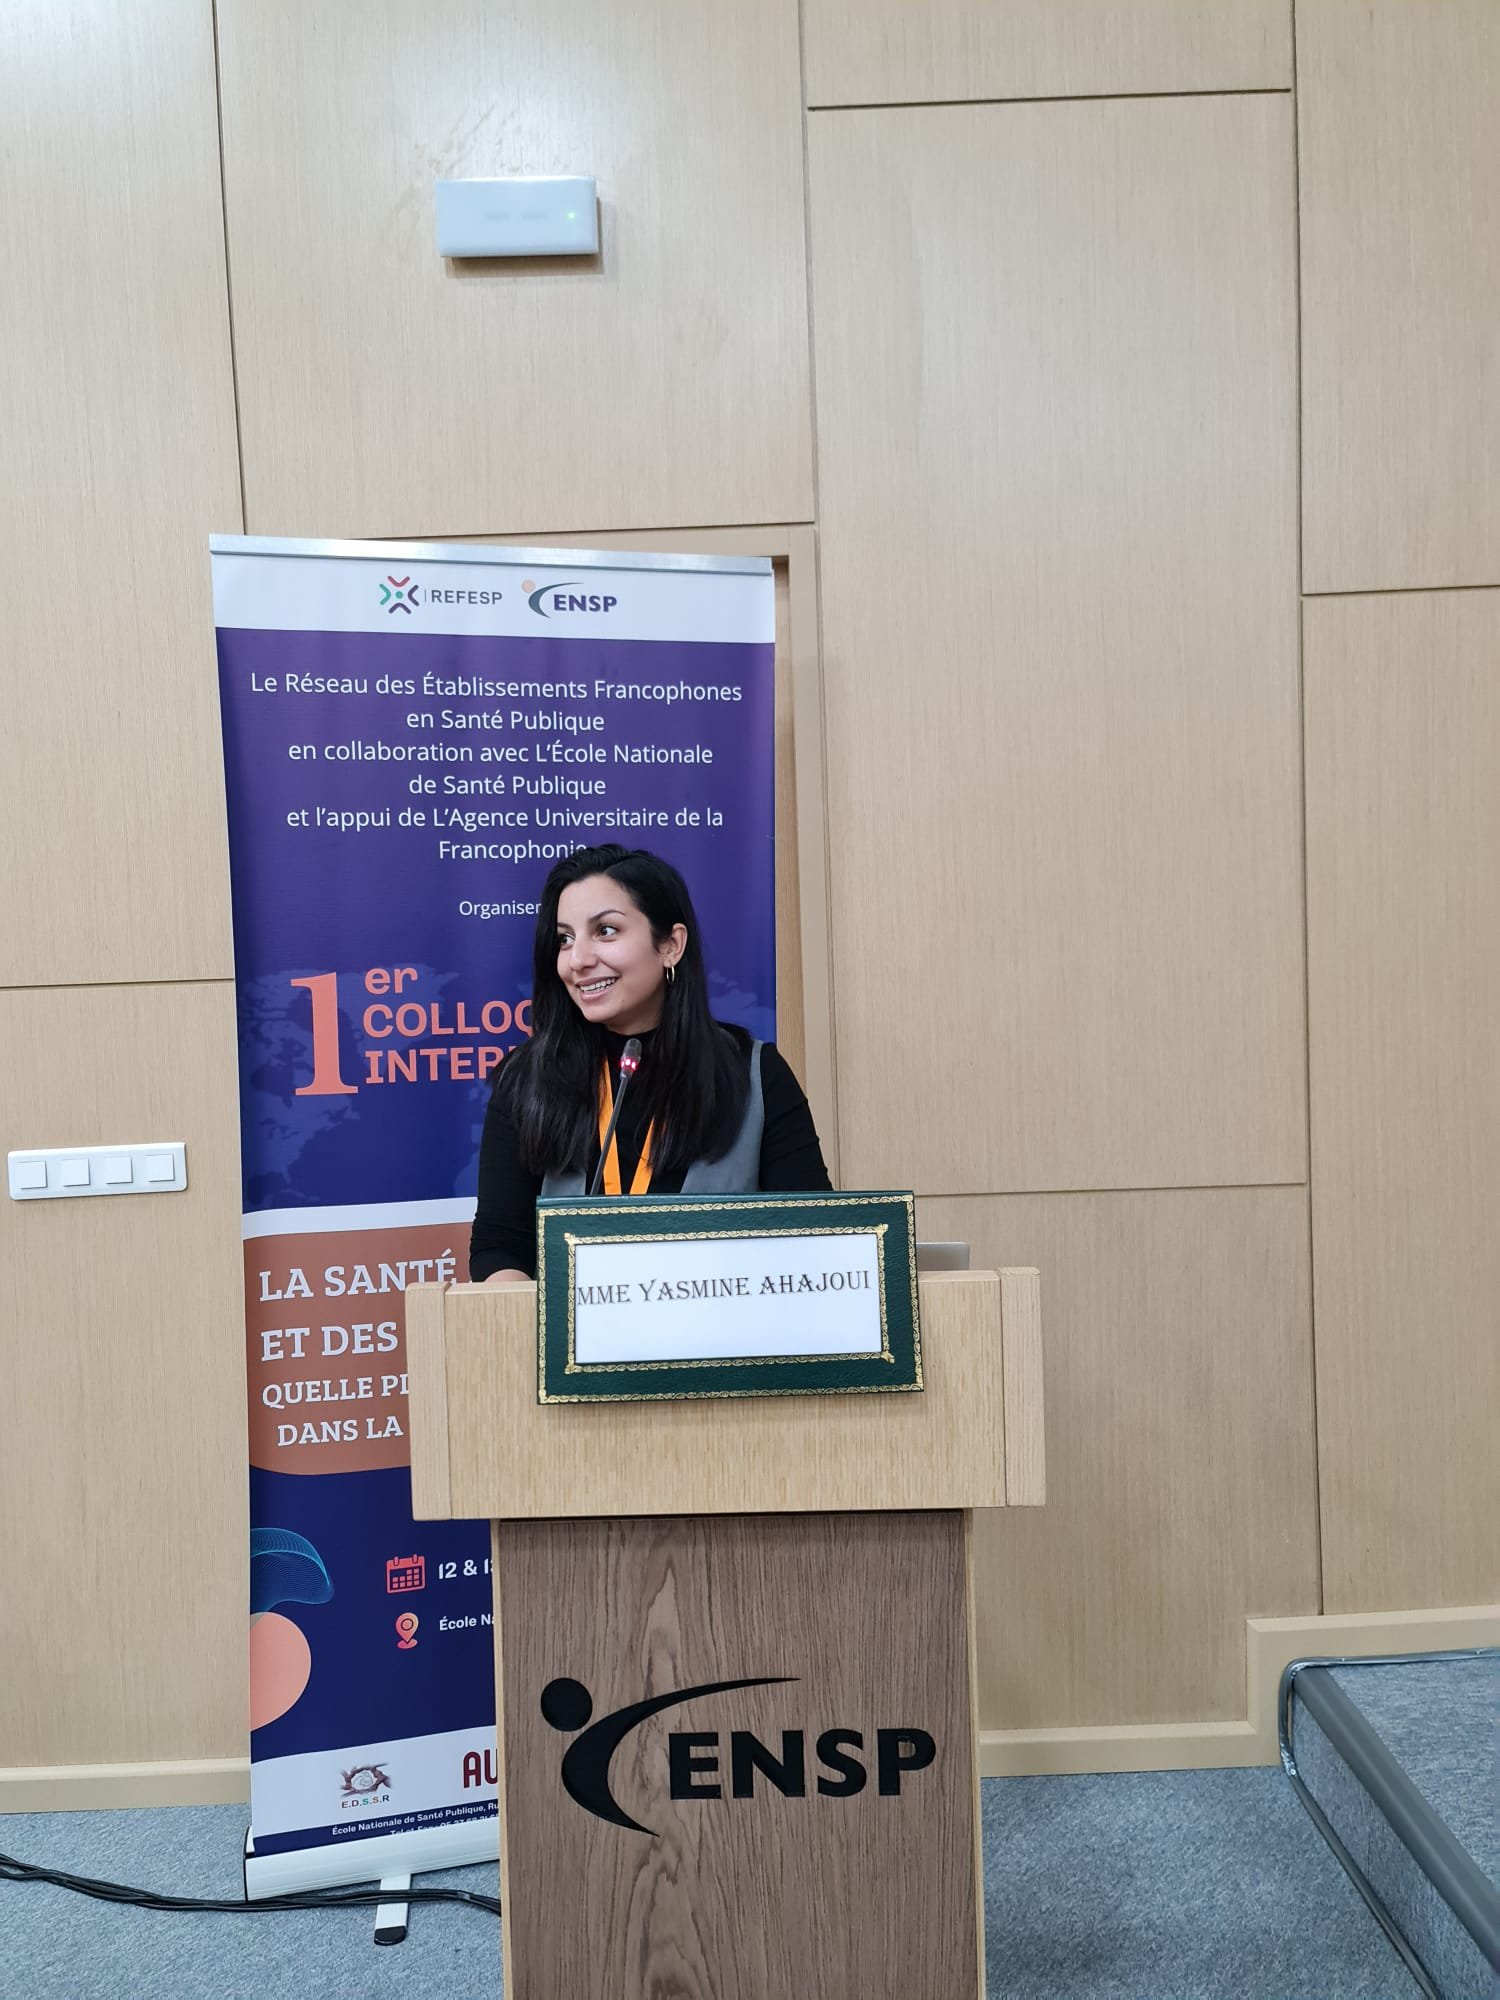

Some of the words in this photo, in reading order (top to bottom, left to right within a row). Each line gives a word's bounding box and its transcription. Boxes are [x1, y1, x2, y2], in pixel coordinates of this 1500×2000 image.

[432, 590, 503, 605] REFESP
[553, 594, 618, 612] ENSP
[251, 672, 277, 692] Le
[285, 672, 368, 694] Réseau
[375, 674, 415, 695] des
[423, 671, 588, 698] Établissements
[594, 680, 742, 704] Francophones
[406, 713, 434, 728] en
[441, 709, 503, 729] Santé
[510, 710, 605, 735] Publique
[288, 744, 316, 760] en
[324, 740, 473, 762] collaboration
[480, 747, 529, 762] avec
[536, 740, 607, 763] L’École
[613, 744, 713, 764] Nationale
[409, 774, 437, 794] de
[443, 774, 505, 795] Santé
[512, 775, 606, 800] Publique
[287, 809, 309, 827] et
[316, 806, 391, 832] l’appui
[398, 807, 426, 827] de
[433, 807, 528, 832] L’Agence
[535, 808, 669, 827] Universitaire
[675, 808, 700, 826] de
[706, 808, 724, 827] la
[365, 1045, 517, 1084] INTER
[259, 1268, 314, 1302] LA
[324, 1248, 457, 1297] SANTÉ
[577, 1284, 631, 1306] MME
[638, 1276, 750, 1303] YASMINE
[759, 1270, 871, 1295] AHAJOUI
[261, 1327, 311, 1361] ET
[321, 1321, 398, 1356] DES
[262, 1377, 373, 1409] QUELLE
[277, 1418, 359, 1446] DANS
[366, 1415, 404, 1440] LA
[439, 1562, 457, 1579] 12
[463, 1559, 478, 1576] &
[484, 1558, 494, 1574] 1
[439, 1615, 477, 1631] École
[668, 1728, 937, 1800] ENSP
[341, 1794, 390, 1809] E.D.S.S.R
[332, 1825, 356, 1836] École
[358, 1817, 402, 1831] Nationale
[404, 1815, 415, 1824] de
[417, 1810, 443, 1822] Santé
